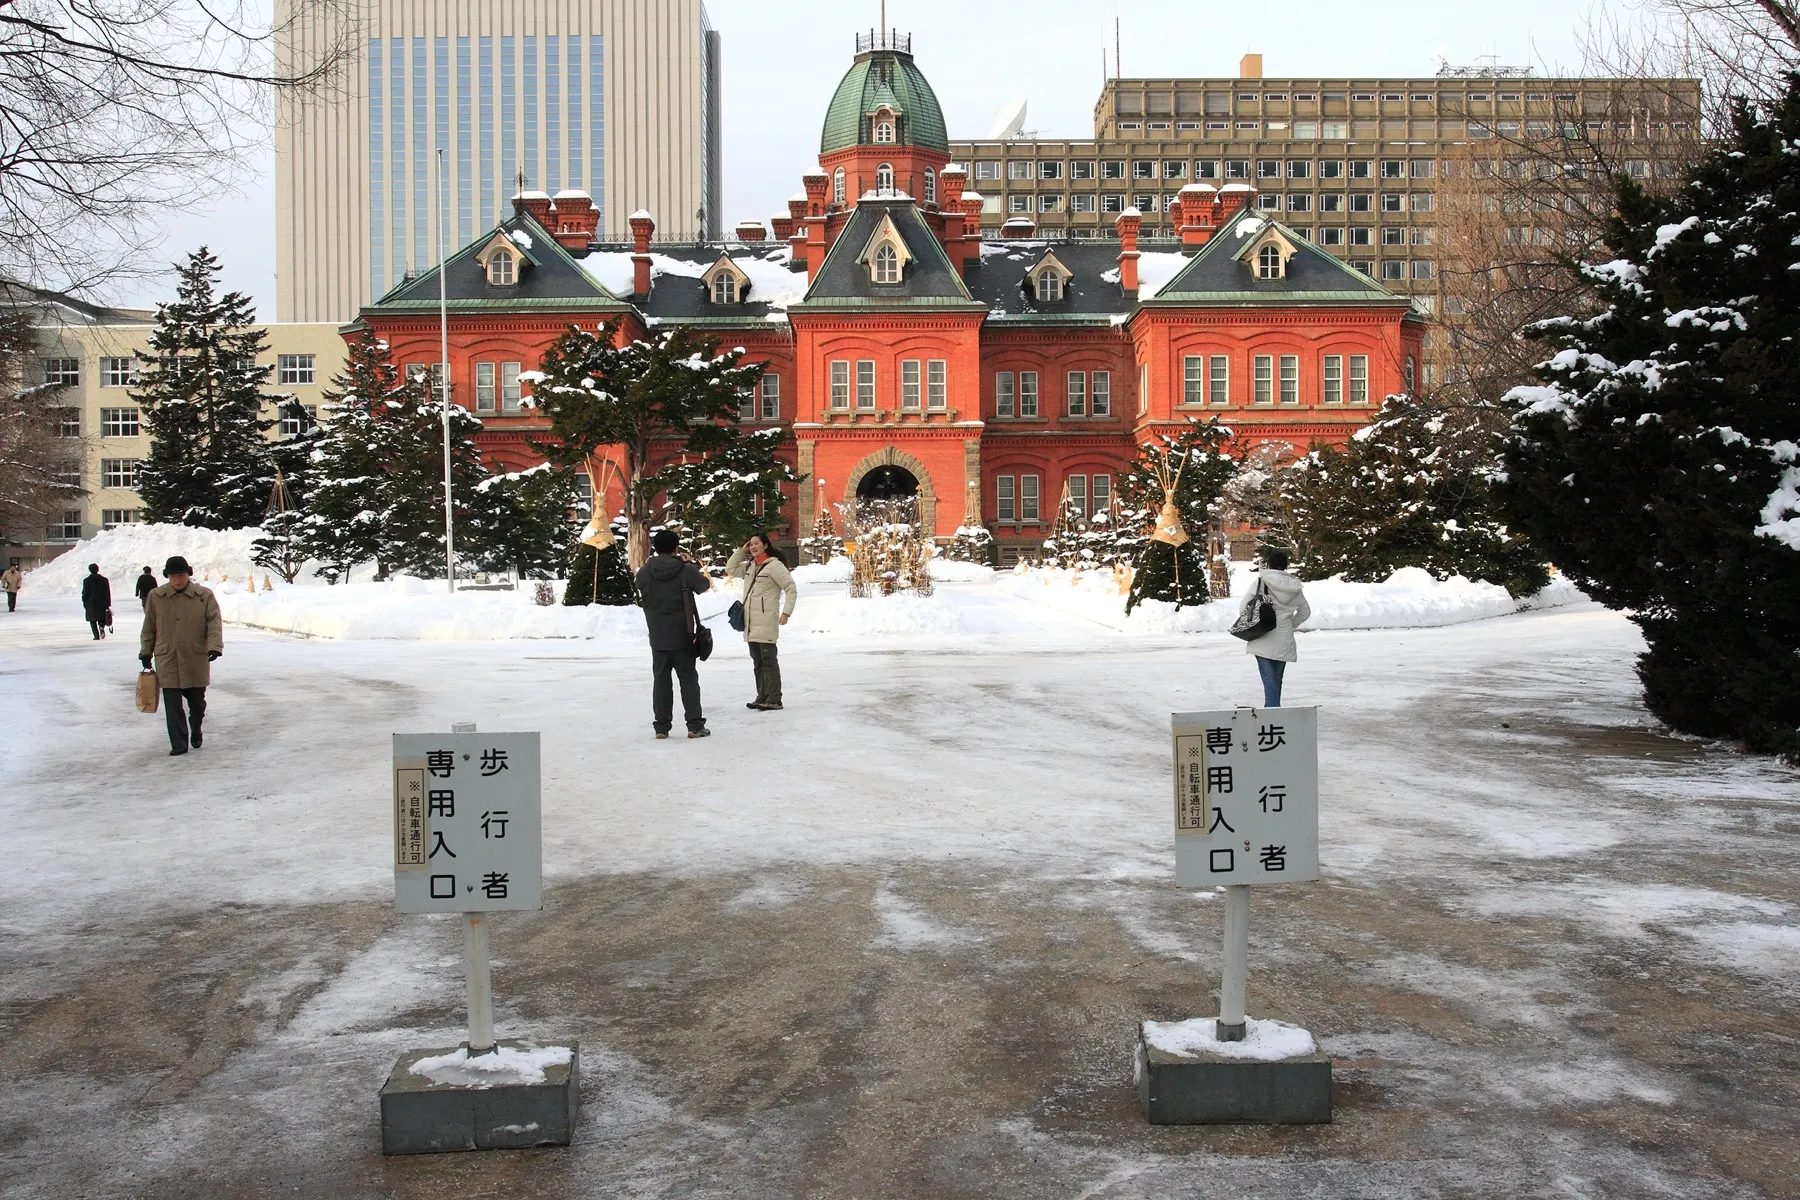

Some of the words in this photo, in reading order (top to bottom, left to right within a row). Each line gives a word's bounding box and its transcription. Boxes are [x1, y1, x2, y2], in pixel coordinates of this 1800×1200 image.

[426, 749, 457, 899] 専用入口
[480, 748, 509, 899] 歩行者
[1206, 727, 1235, 873] 専用入口
[1258, 724, 1287, 871] 歩行者
